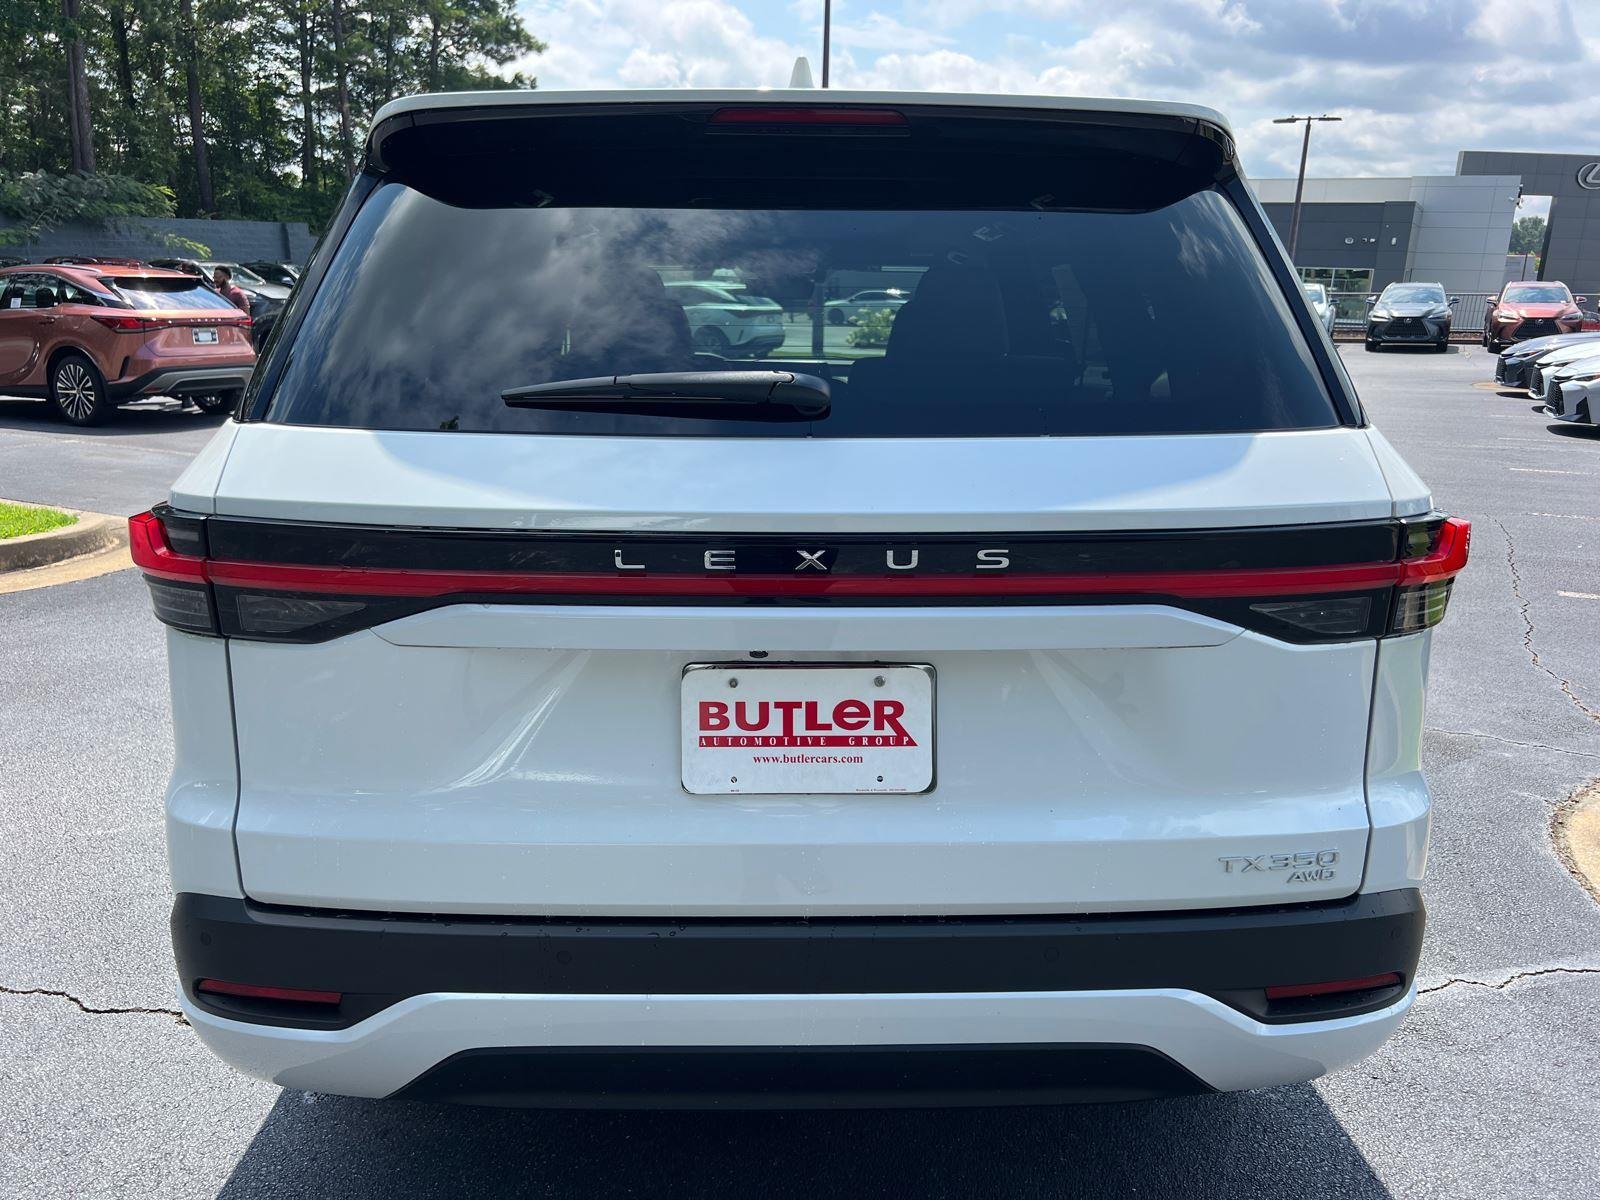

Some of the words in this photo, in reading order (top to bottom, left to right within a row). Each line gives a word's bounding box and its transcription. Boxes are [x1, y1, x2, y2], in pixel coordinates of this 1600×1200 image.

[614, 549, 1010, 571] LEXUS
[700, 736, 827, 746] AUTOMOTIVE
[849, 736, 910, 746] GROUP
[753, 753, 864, 764] www.butlercars.com
[1286, 868, 1337, 883] AWD
